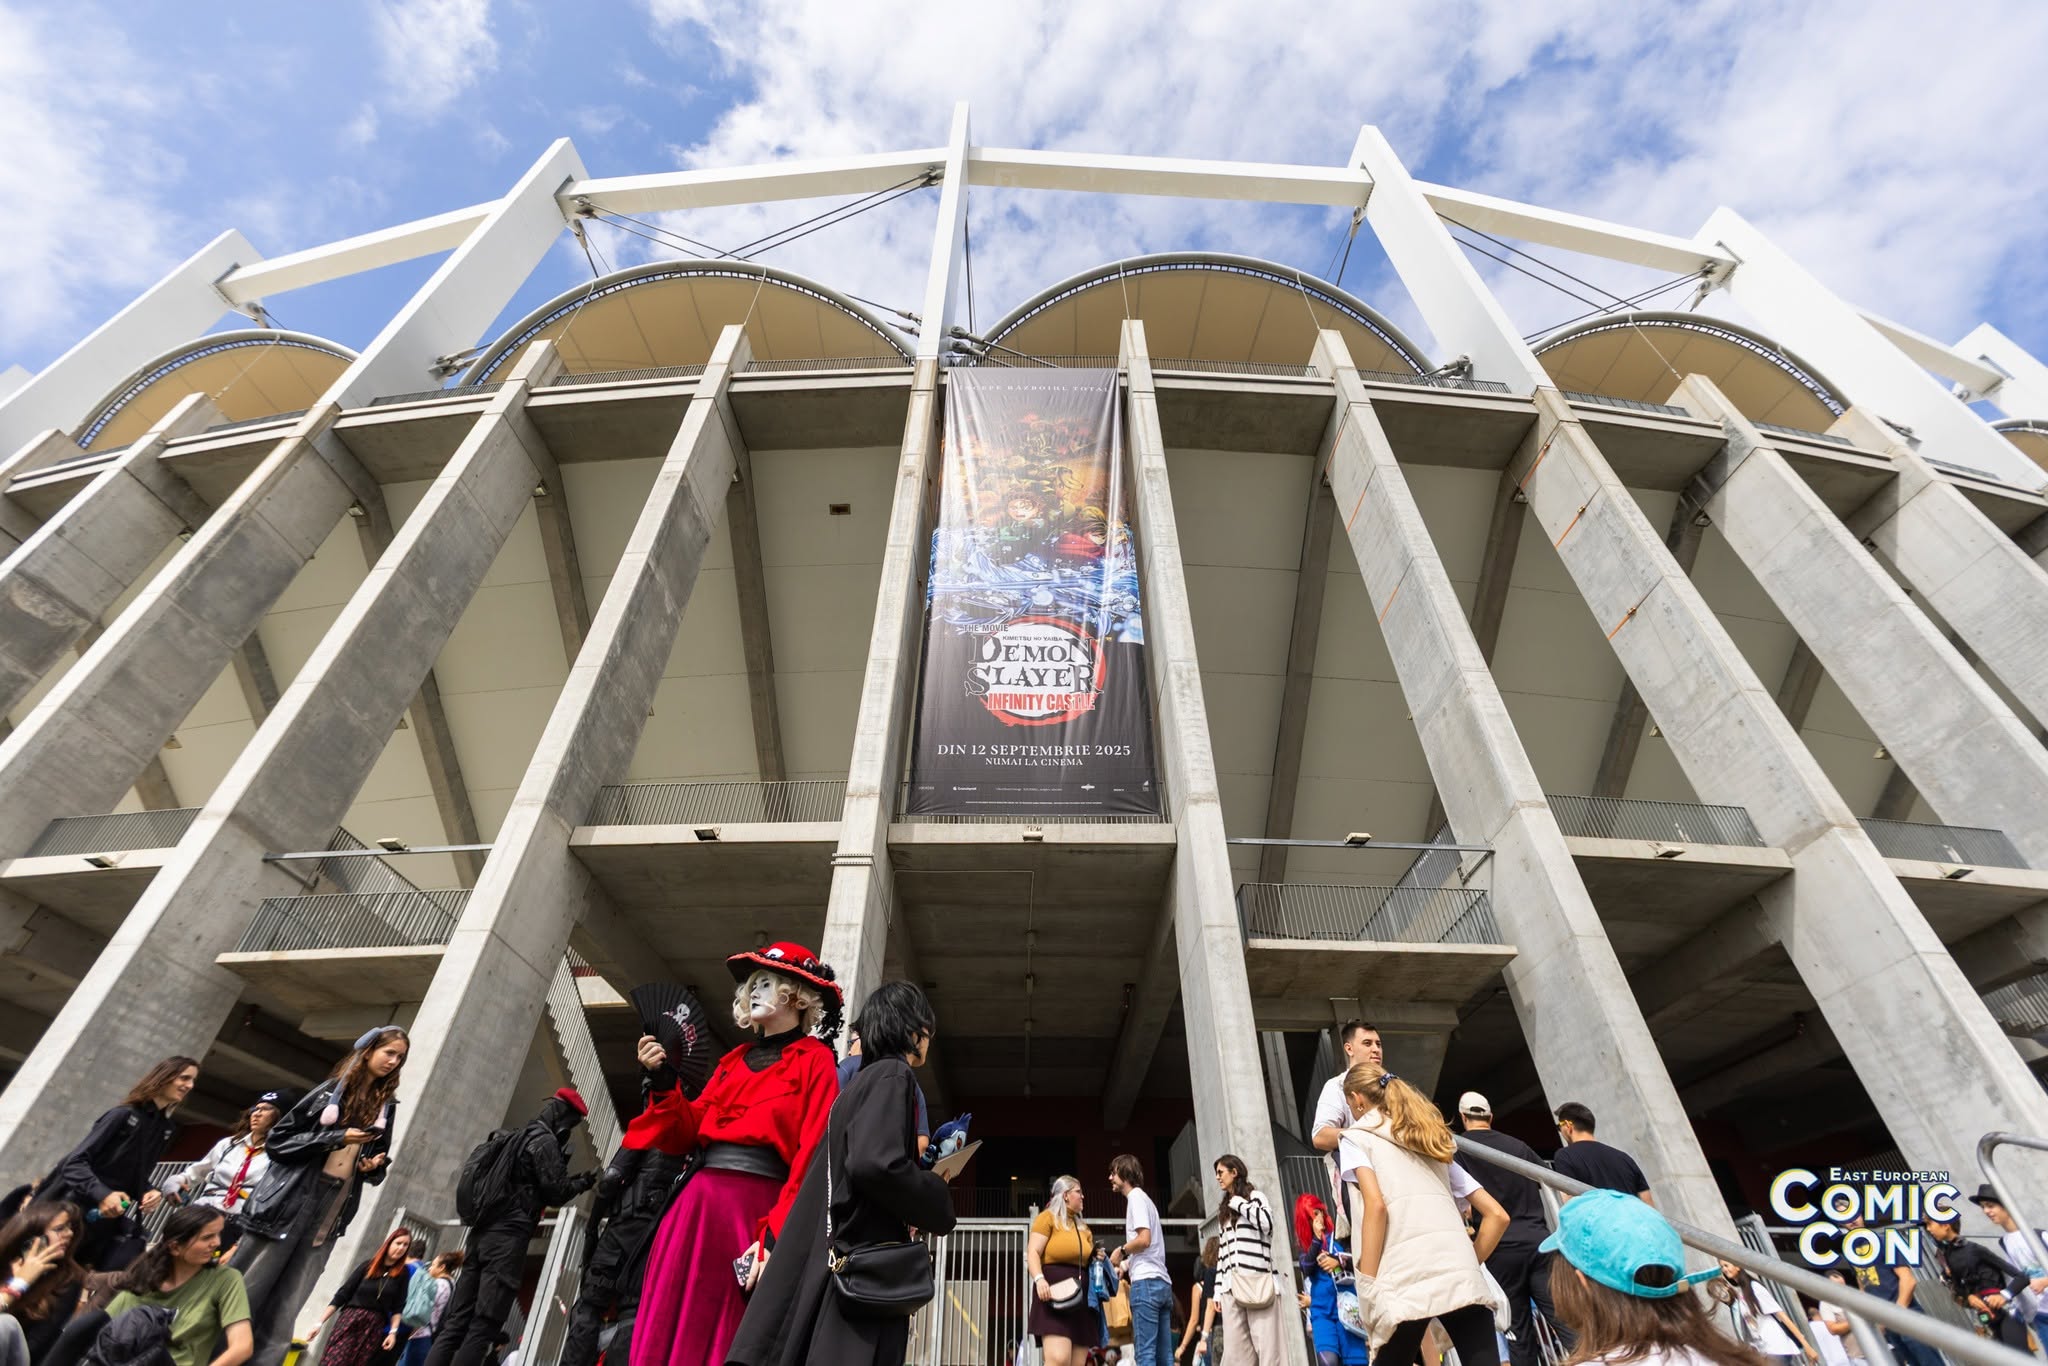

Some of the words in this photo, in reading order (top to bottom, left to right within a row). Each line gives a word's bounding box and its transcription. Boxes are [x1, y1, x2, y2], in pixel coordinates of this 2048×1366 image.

[963, 624, 981, 632] THE
[983, 624, 1009, 632] MOVIE
[968, 633, 1094, 665] DEMON
[964, 664, 1104, 696] SLAYER
[988, 693, 1044, 710] INFINITY
[1046, 692, 1096, 710] CASTLE
[938, 744, 967, 755] DIN
[971, 744, 986, 755] 12
[990, 744, 1091, 756] SEPTEMBRIE
[1095, 744, 1131, 756] 2025
[985, 757, 1022, 766] NUMAI
[1025, 758, 1038, 766] LA
[1040, 758, 1083, 766] CINEMA
